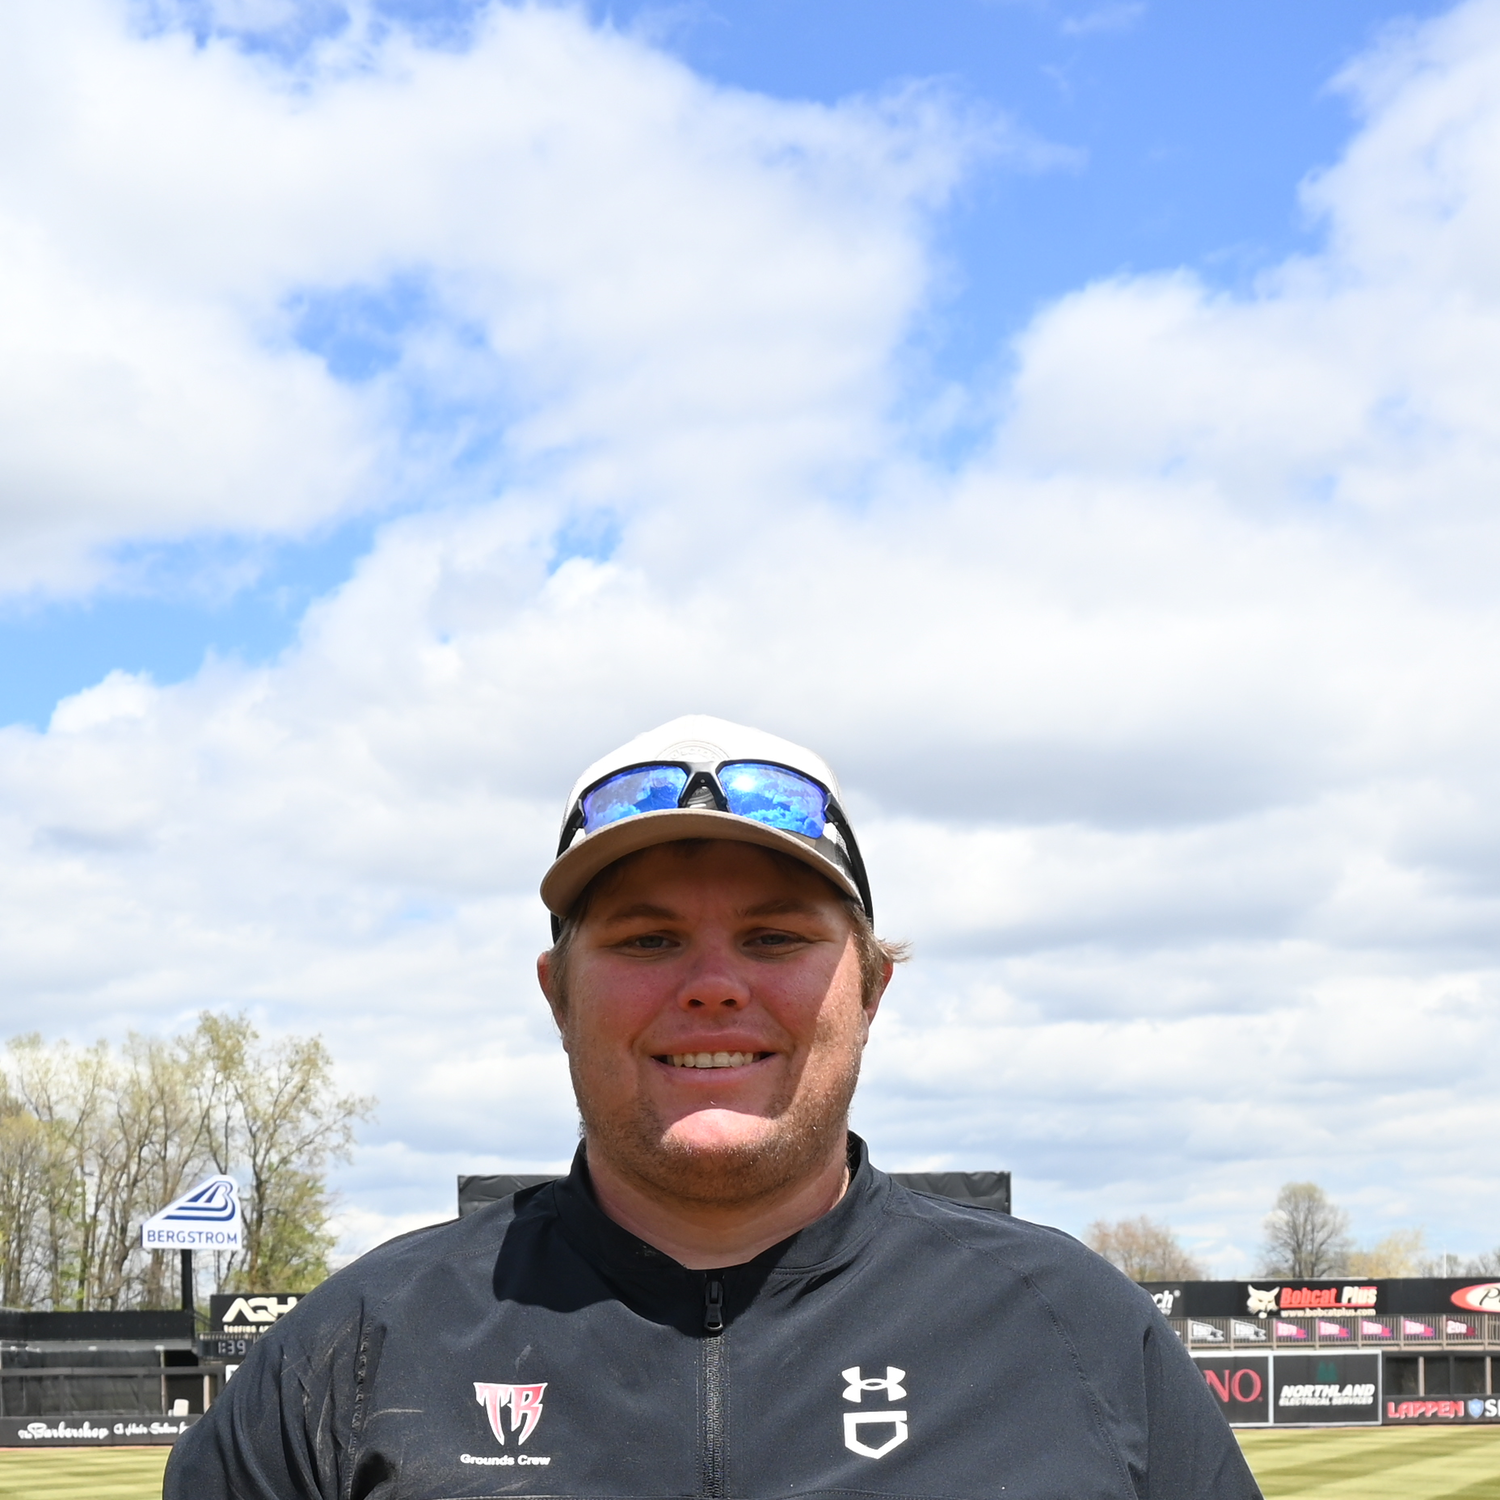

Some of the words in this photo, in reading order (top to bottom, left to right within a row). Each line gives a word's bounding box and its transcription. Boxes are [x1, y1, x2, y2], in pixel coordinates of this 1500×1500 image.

[147, 1230, 238, 1245] BERGSTROM
[1280, 1287, 1338, 1306] Bobcat
[1341, 1286, 1378, 1305] Plus
[1280, 1308, 1377, 1317] www.bobcatplus.com
[217, 1340, 246, 1355] 1:39
[1280, 1384, 1376, 1398] NORTHLAND
[1279, 1397, 1330, 1406] ELECTRICAL
[1332, 1396, 1374, 1406] SERVICES
[1387, 1400, 1465, 1419] LAPPEN
[28, 1421, 109, 1440] Barbershop
[460, 1453, 515, 1466] Grounds
[517, 1454, 551, 1466] Crew
